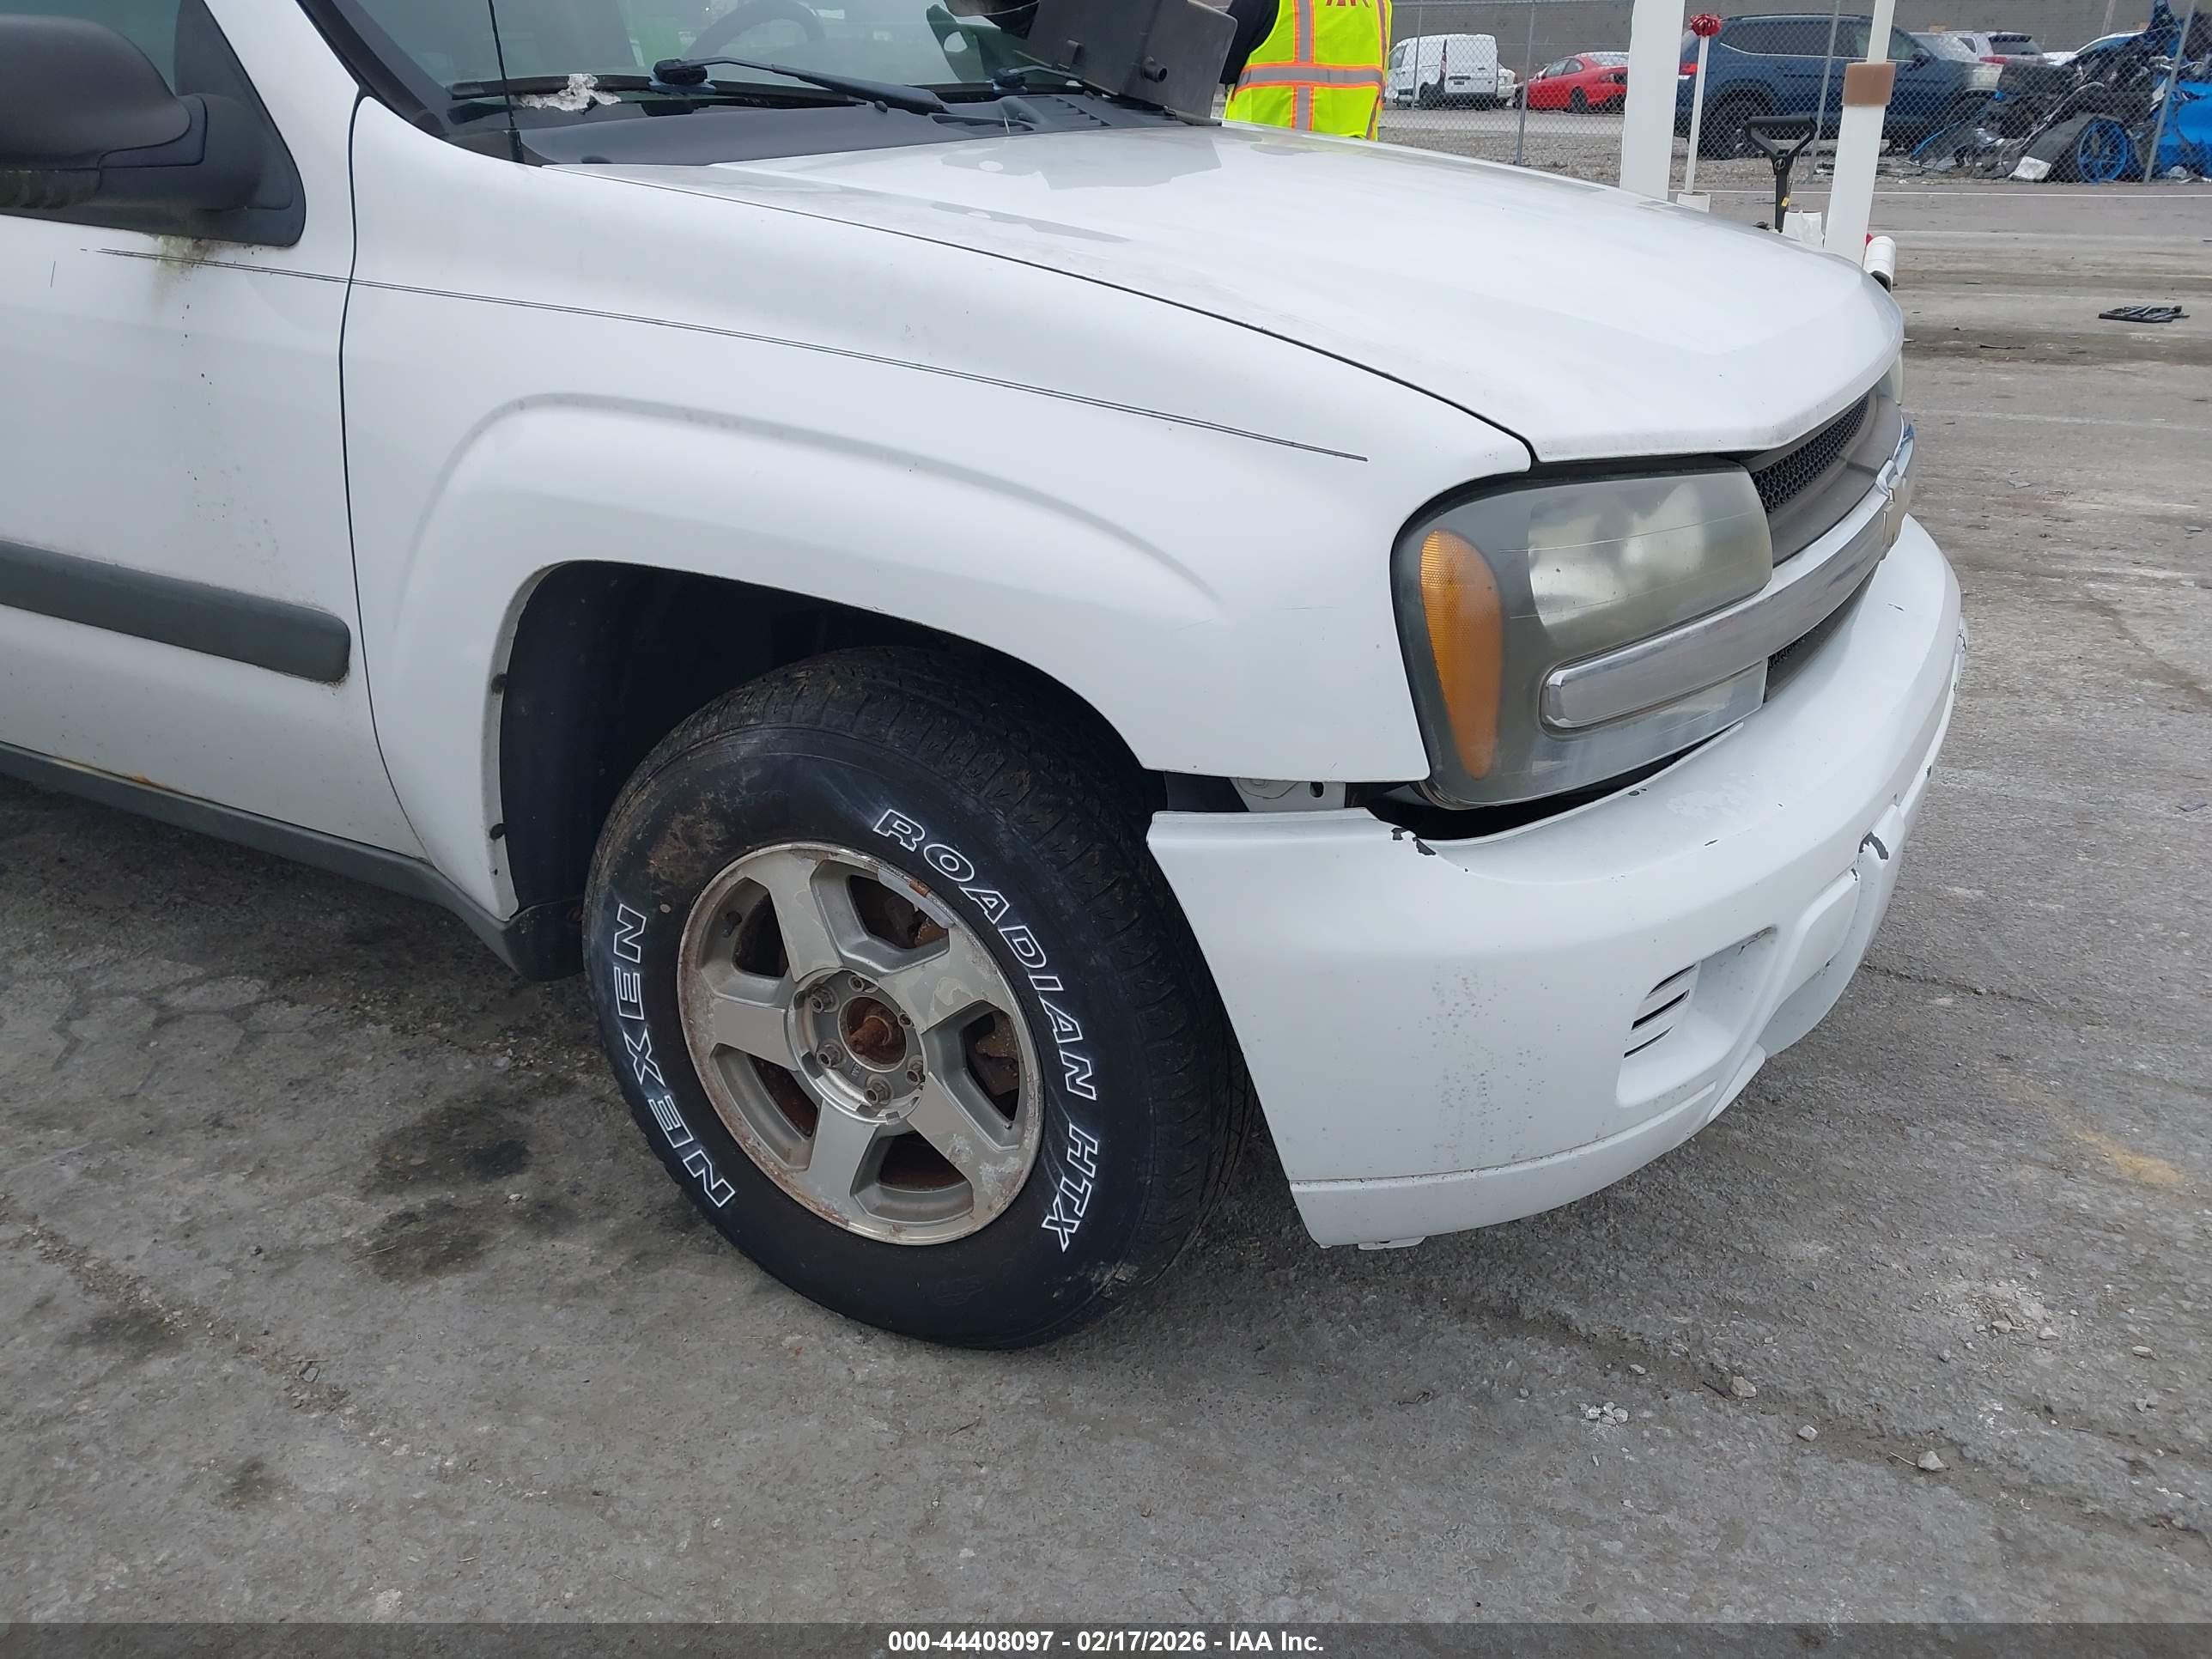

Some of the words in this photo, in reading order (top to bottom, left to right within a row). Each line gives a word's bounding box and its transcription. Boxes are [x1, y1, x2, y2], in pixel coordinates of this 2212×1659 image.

[613, 902, 737, 1209] NEXEN
[872, 808, 1098, 1102] ROADIAN
[1042, 1120, 1100, 1254] HTX
